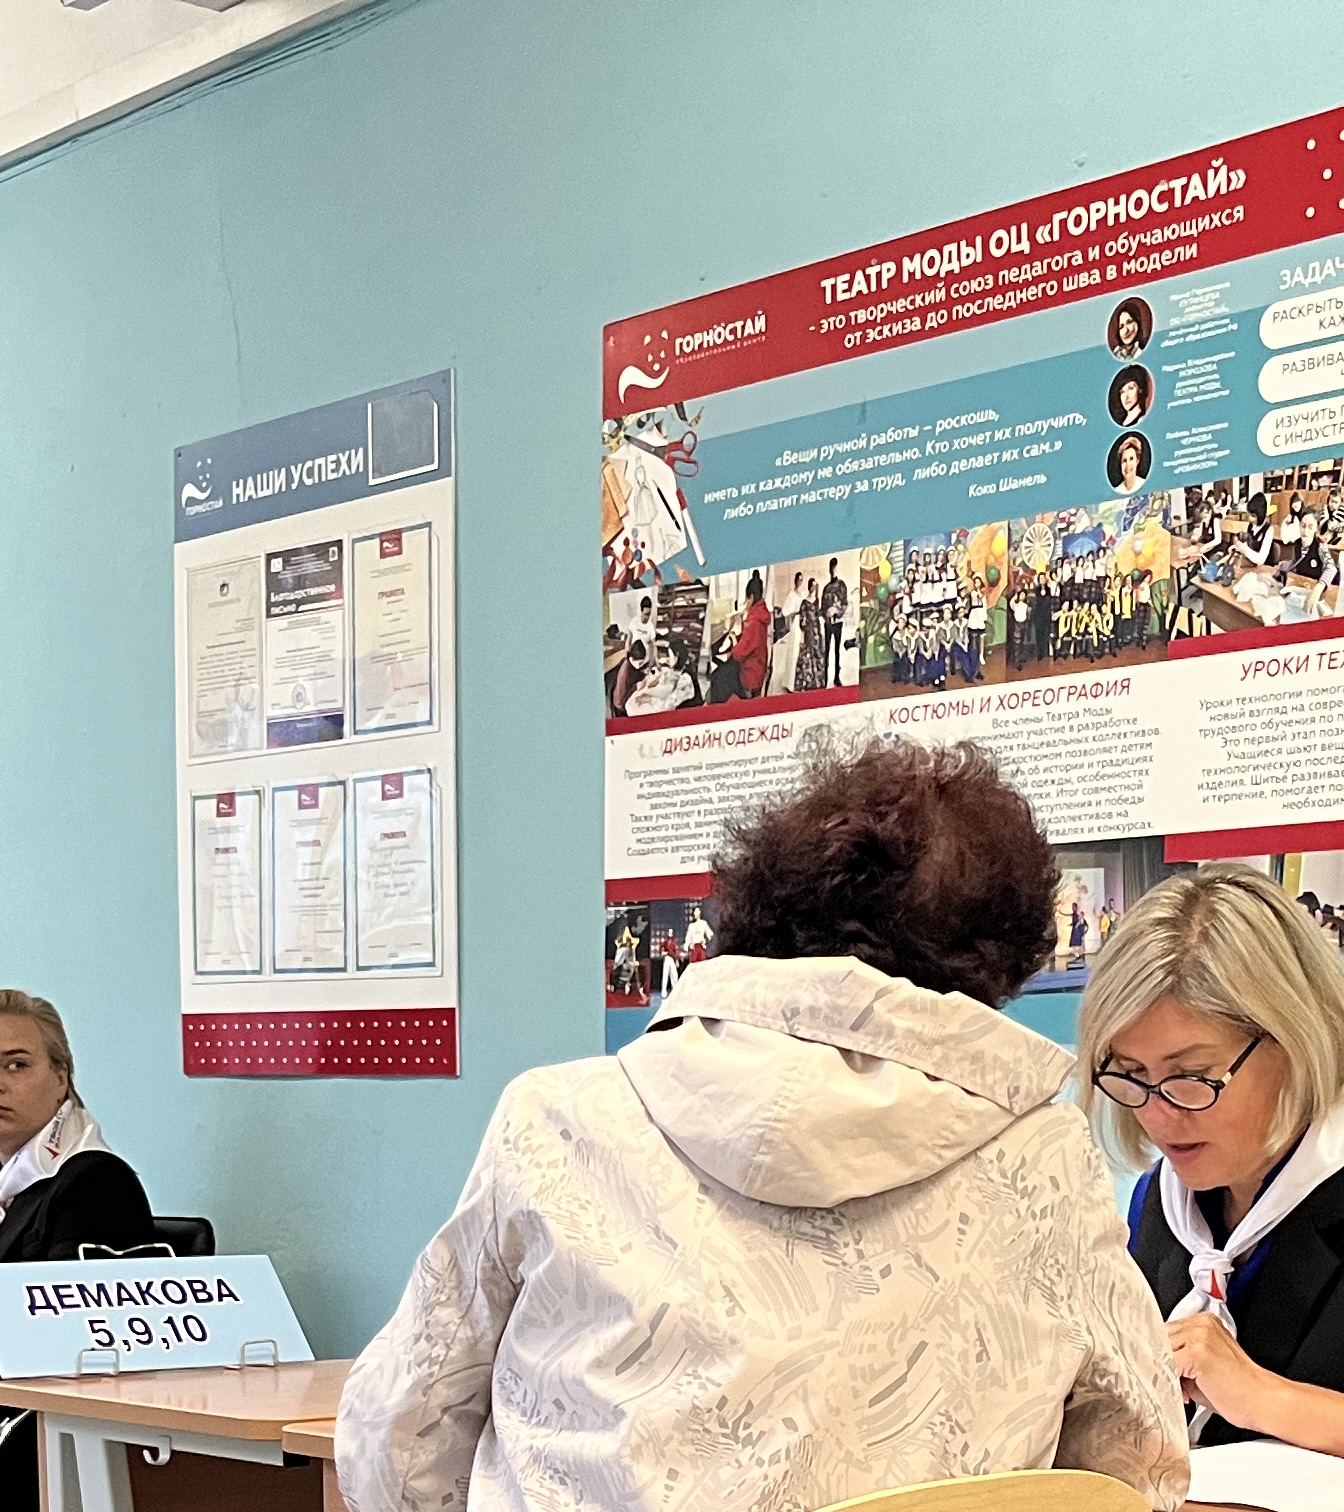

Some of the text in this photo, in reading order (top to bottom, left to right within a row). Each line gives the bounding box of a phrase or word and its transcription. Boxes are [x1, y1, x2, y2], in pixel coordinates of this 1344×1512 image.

[820, 157, 1248, 304] ТЕАТР МОДЫ ОЦ «ГОРНОСТАЙ»
[819, 204, 1244, 333] это творческий союз педагога и обучающихся
[843, 242, 1197, 348] от эскиза до последнего шва в модели
[1272, 297, 1343, 323] РАСКРЫТЬ
[674, 310, 765, 356] ГОРНОСТАЙ
[1275, 407, 1336, 429] ИЗУЧИТЬ
[758, 469, 815, 492] каждому
[816, 465, 833, 479] не
[925, 439, 950, 456] Кто
[951, 430, 992, 450] хочет
[774, 447, 818, 466] «Вещи
[819, 432, 868, 462] ручной
[869, 425, 920, 450] работы
[1272, 434, 1280, 447] С
[232, 446, 363, 504] НАШИ УСПЕХИ
[723, 500, 754, 520] либо
[755, 494, 798, 513] платит
[799, 483, 852, 504] мастеру
[853, 479, 869, 493] за
[912, 461, 947, 480] либо
[948, 451, 1000, 476] делает
[968, 473, 1047, 498] Коко Шанель
[1240, 654, 1309, 681] УРОКИ
[888, 677, 1131, 724] КОСТЮМЫ И ХОРЕОГРАФИЯ
[724, 722, 793, 747] ОДЕЖДЫ
[25, 1278, 241, 1316] ДЕМАКОВА
[87, 1314, 208, 1351] 5,9,10
